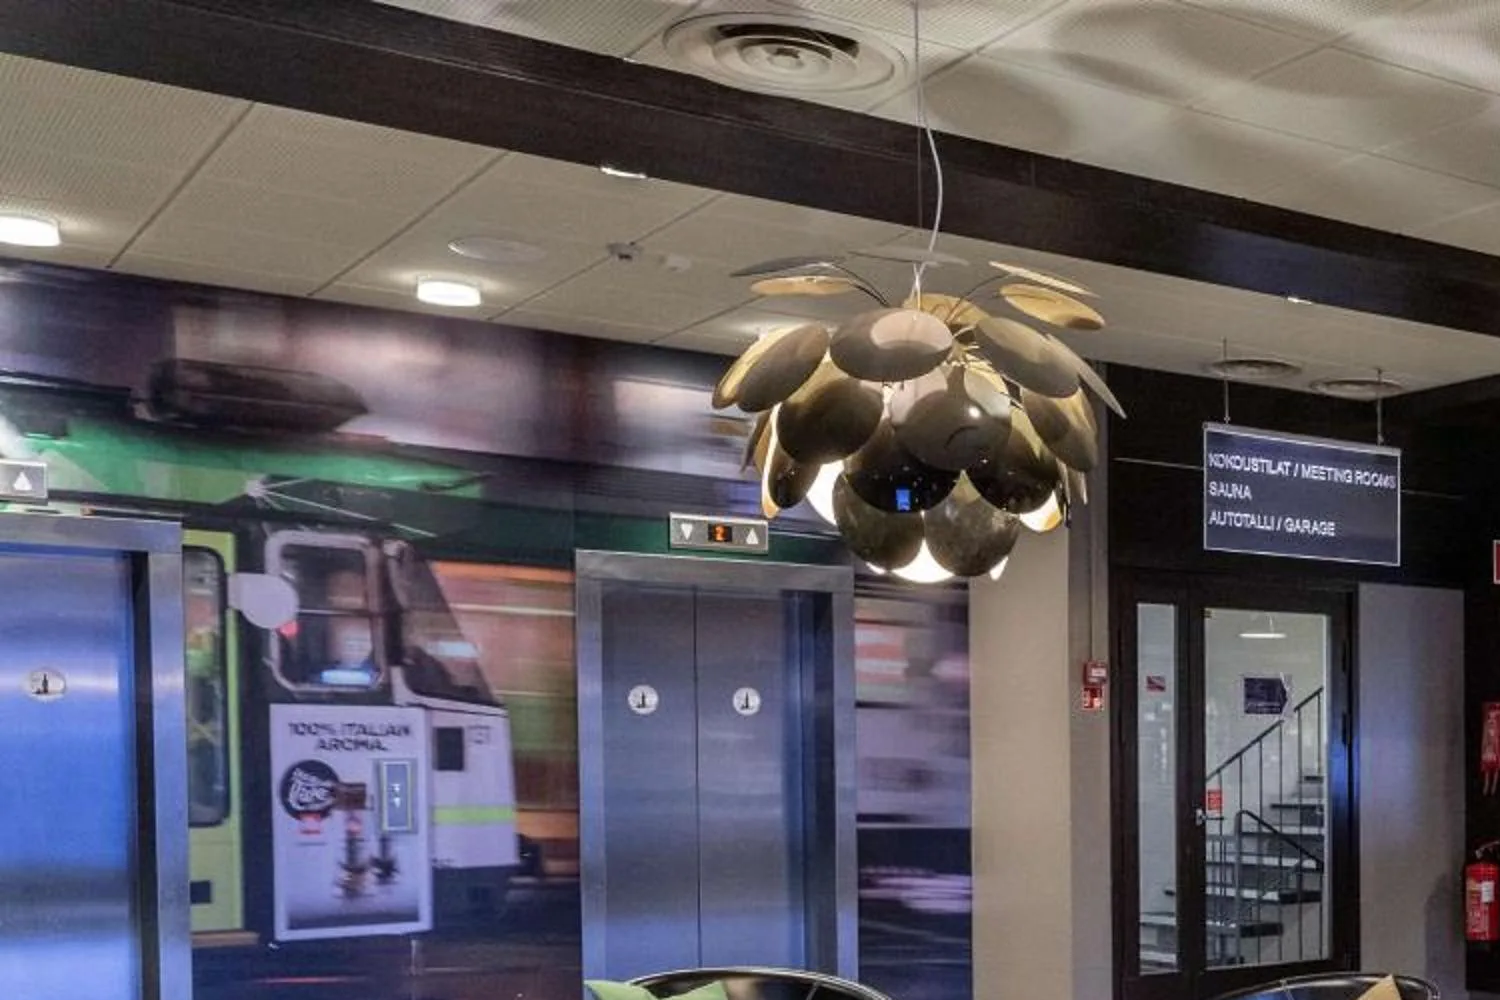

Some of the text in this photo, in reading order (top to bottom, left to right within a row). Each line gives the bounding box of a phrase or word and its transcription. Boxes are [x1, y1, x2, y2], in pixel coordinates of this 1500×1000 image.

[1208, 453, 1291, 477] KOKOUSTILAT
[1301, 465, 1352, 483] MEETING
[1354, 471, 1397, 489] ROOMS
[1208, 481, 1252, 500] SAUNA
[1208, 509, 1275, 531] AUTOTALLI
[1283, 518, 1336, 537] GARAGE
